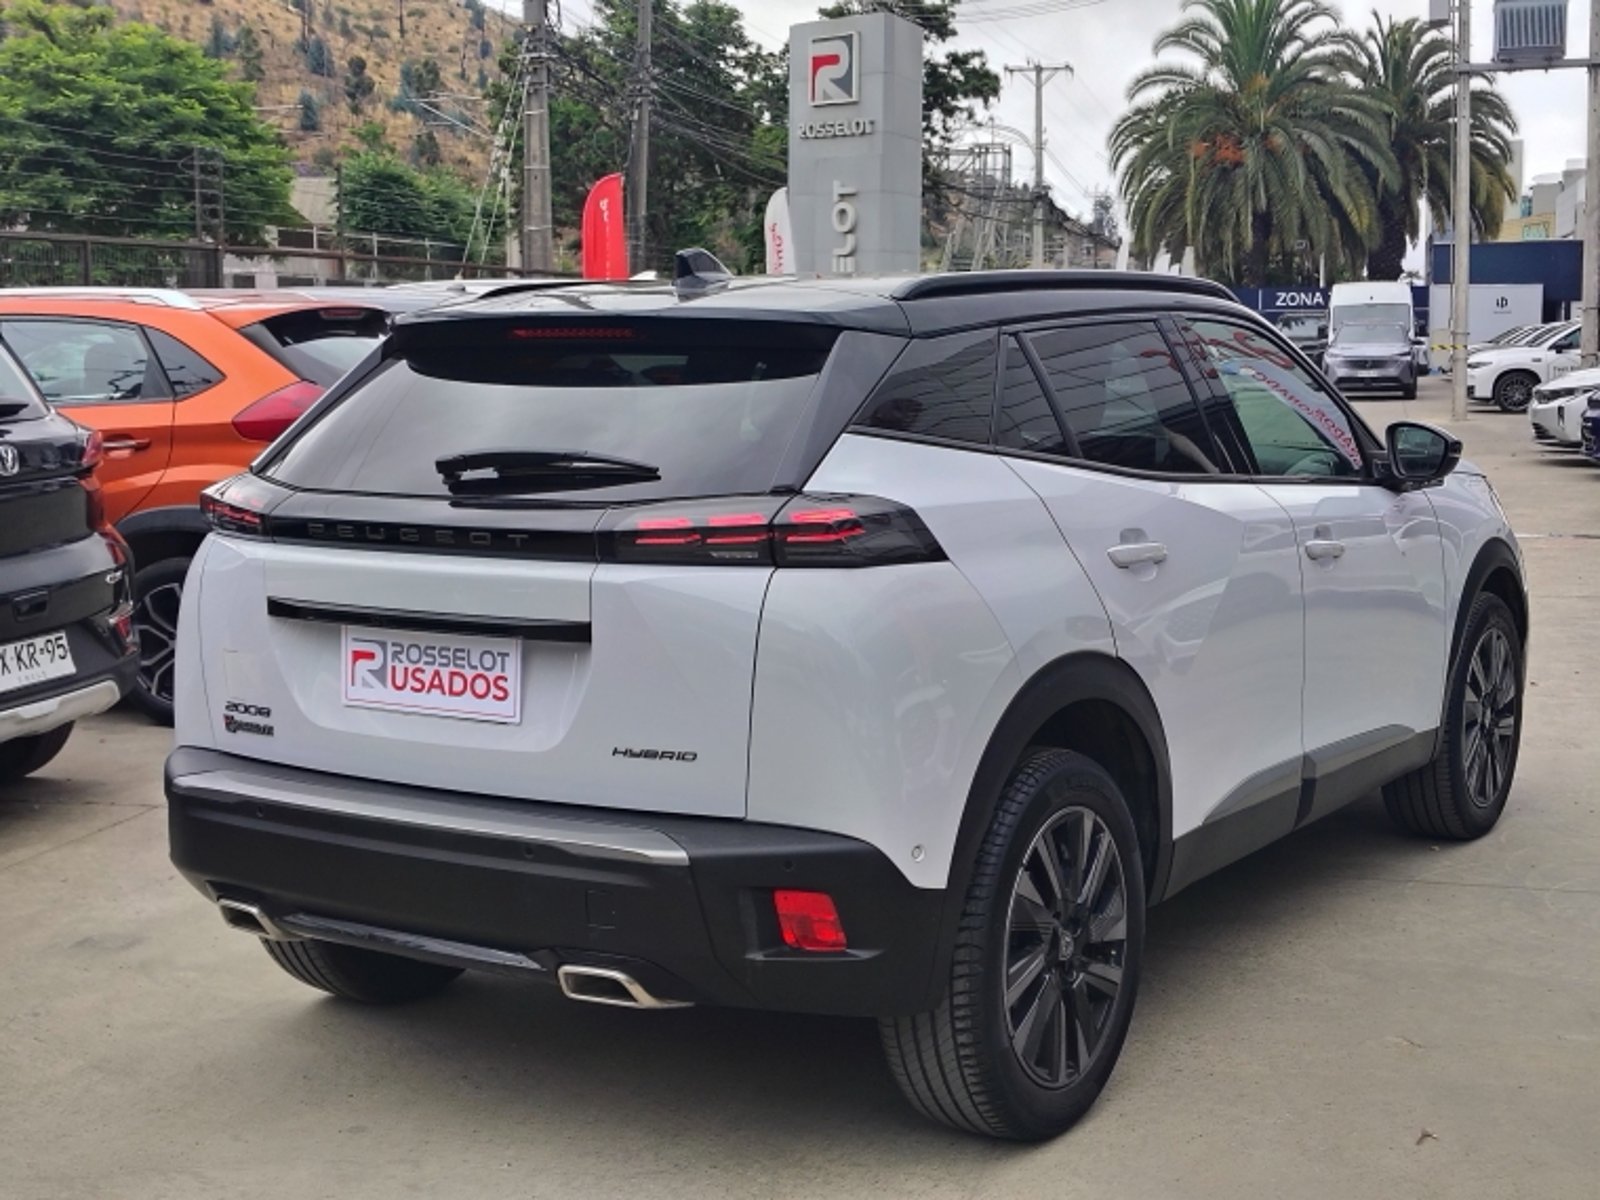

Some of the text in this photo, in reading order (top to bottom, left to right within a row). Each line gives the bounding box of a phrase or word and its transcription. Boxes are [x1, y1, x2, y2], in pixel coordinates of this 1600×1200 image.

[799, 119, 874, 139] ROSSELOT
[1275, 291, 1325, 307] ZONA
[307, 522, 529, 548] PEUGEOT
[391, 642, 510, 673] ROSSELOT
[391, 665, 509, 701] USADOS
[225, 700, 272, 718] 2008
[612, 747, 698, 762] HYBRID
